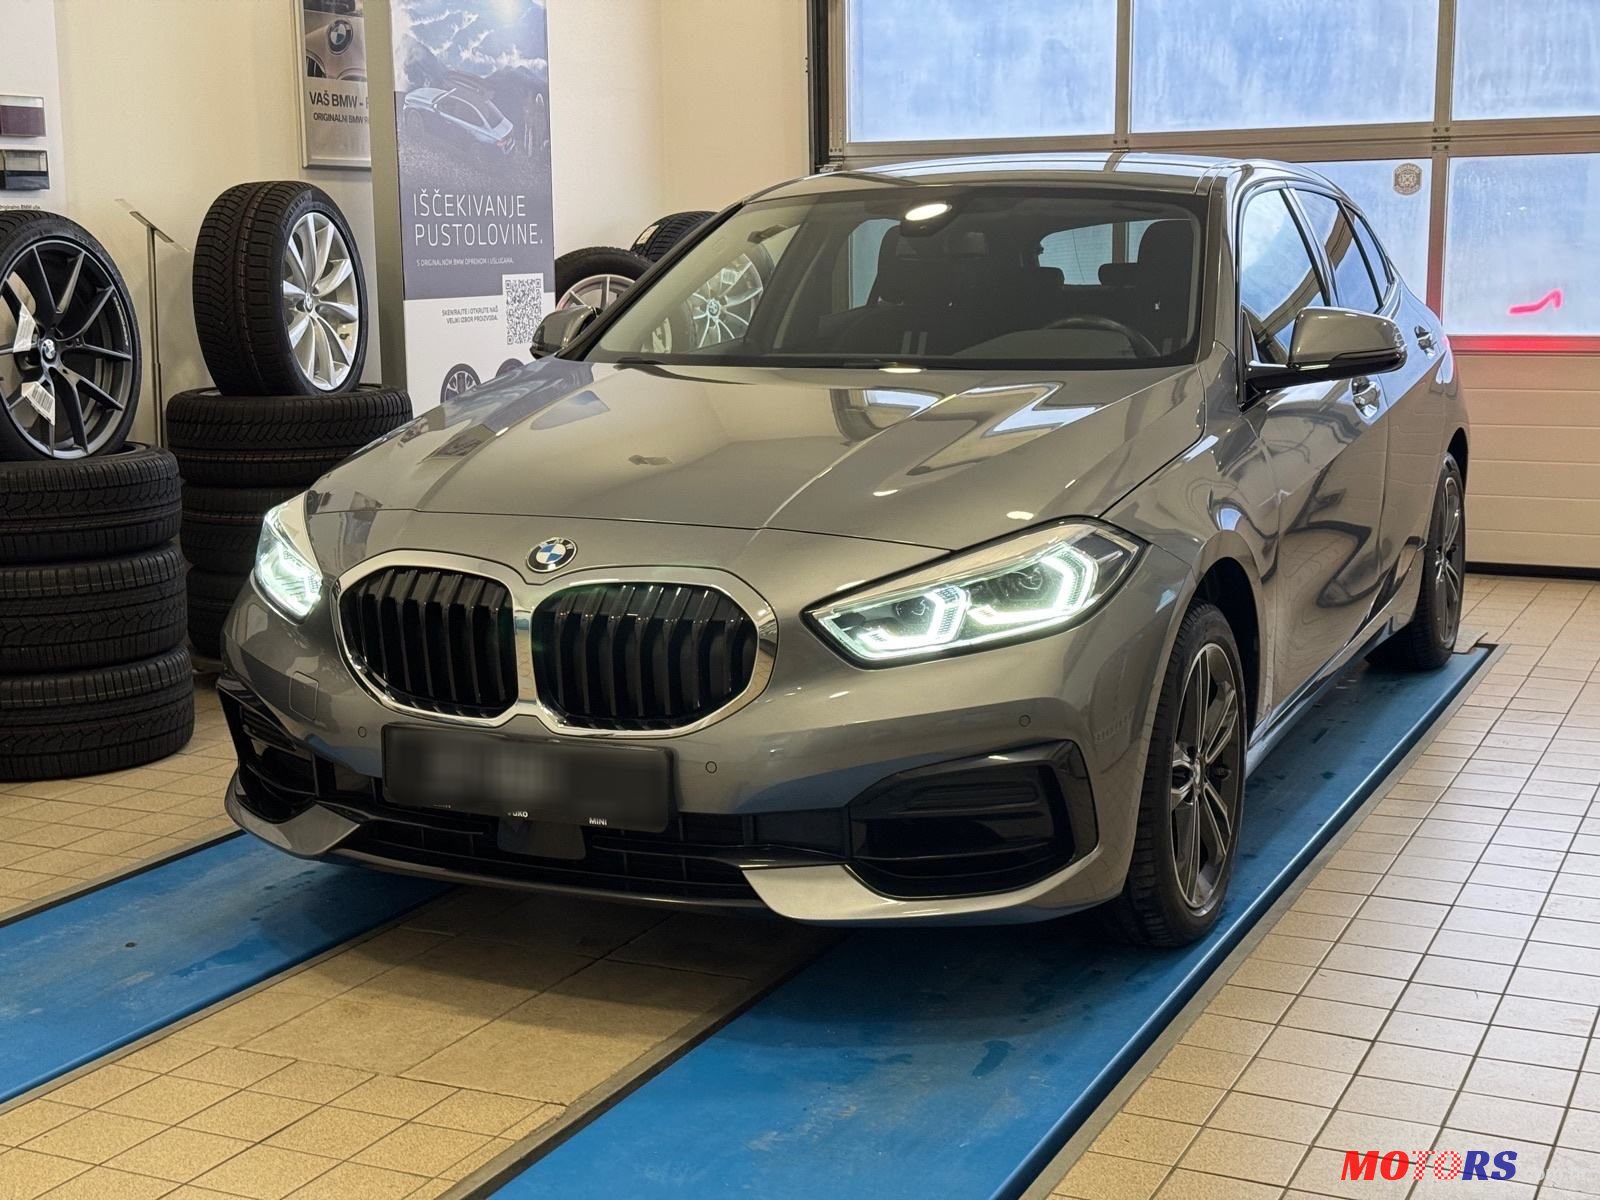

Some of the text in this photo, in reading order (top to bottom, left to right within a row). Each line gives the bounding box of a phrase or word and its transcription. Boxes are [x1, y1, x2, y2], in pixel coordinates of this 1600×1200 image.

[309, 89, 330, 107] VAŠ
[331, 93, 358, 109] BMW
[313, 112, 348, 123] ORIGINALNI
[413, 188, 526, 218] IŠČEKIVANJE
[415, 223, 543, 246] PUSTOLOVINE.
[588, 817, 608, 826] MINI
